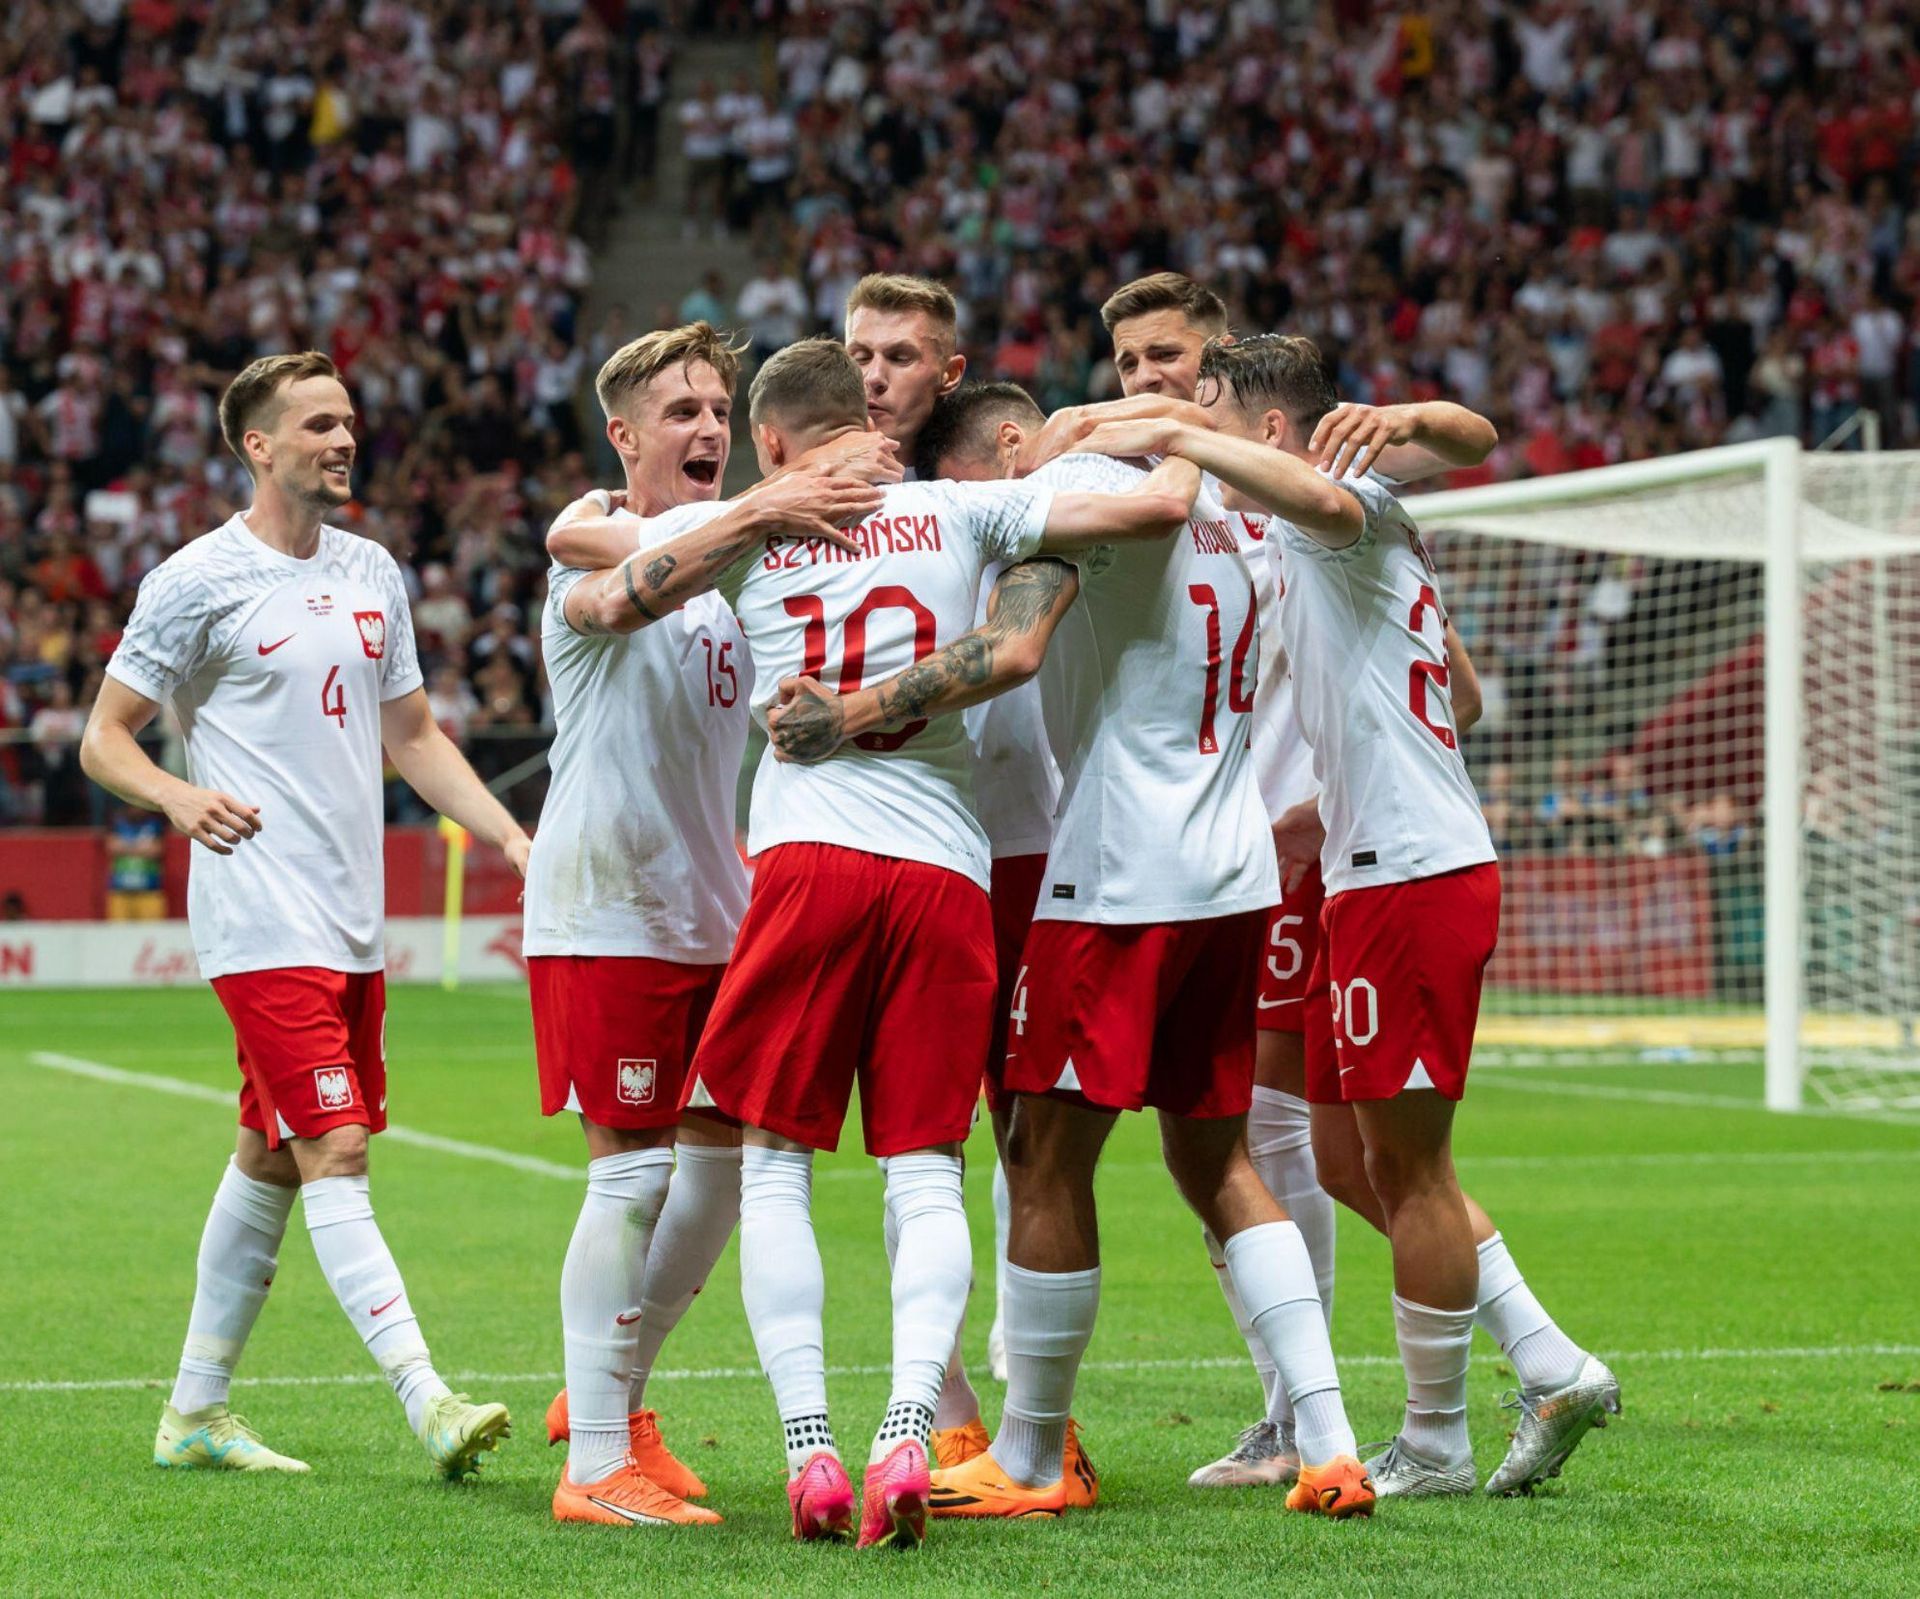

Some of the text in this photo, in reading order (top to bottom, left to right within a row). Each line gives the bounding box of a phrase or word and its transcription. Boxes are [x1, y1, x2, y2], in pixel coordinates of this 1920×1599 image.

[764, 512, 942, 571] SZYMAŃSKI
[321, 664, 347, 729] 4
[702, 638, 738, 708] 15
[783, 585, 937, 752] 10
[1266, 914, 1304, 980] 5
